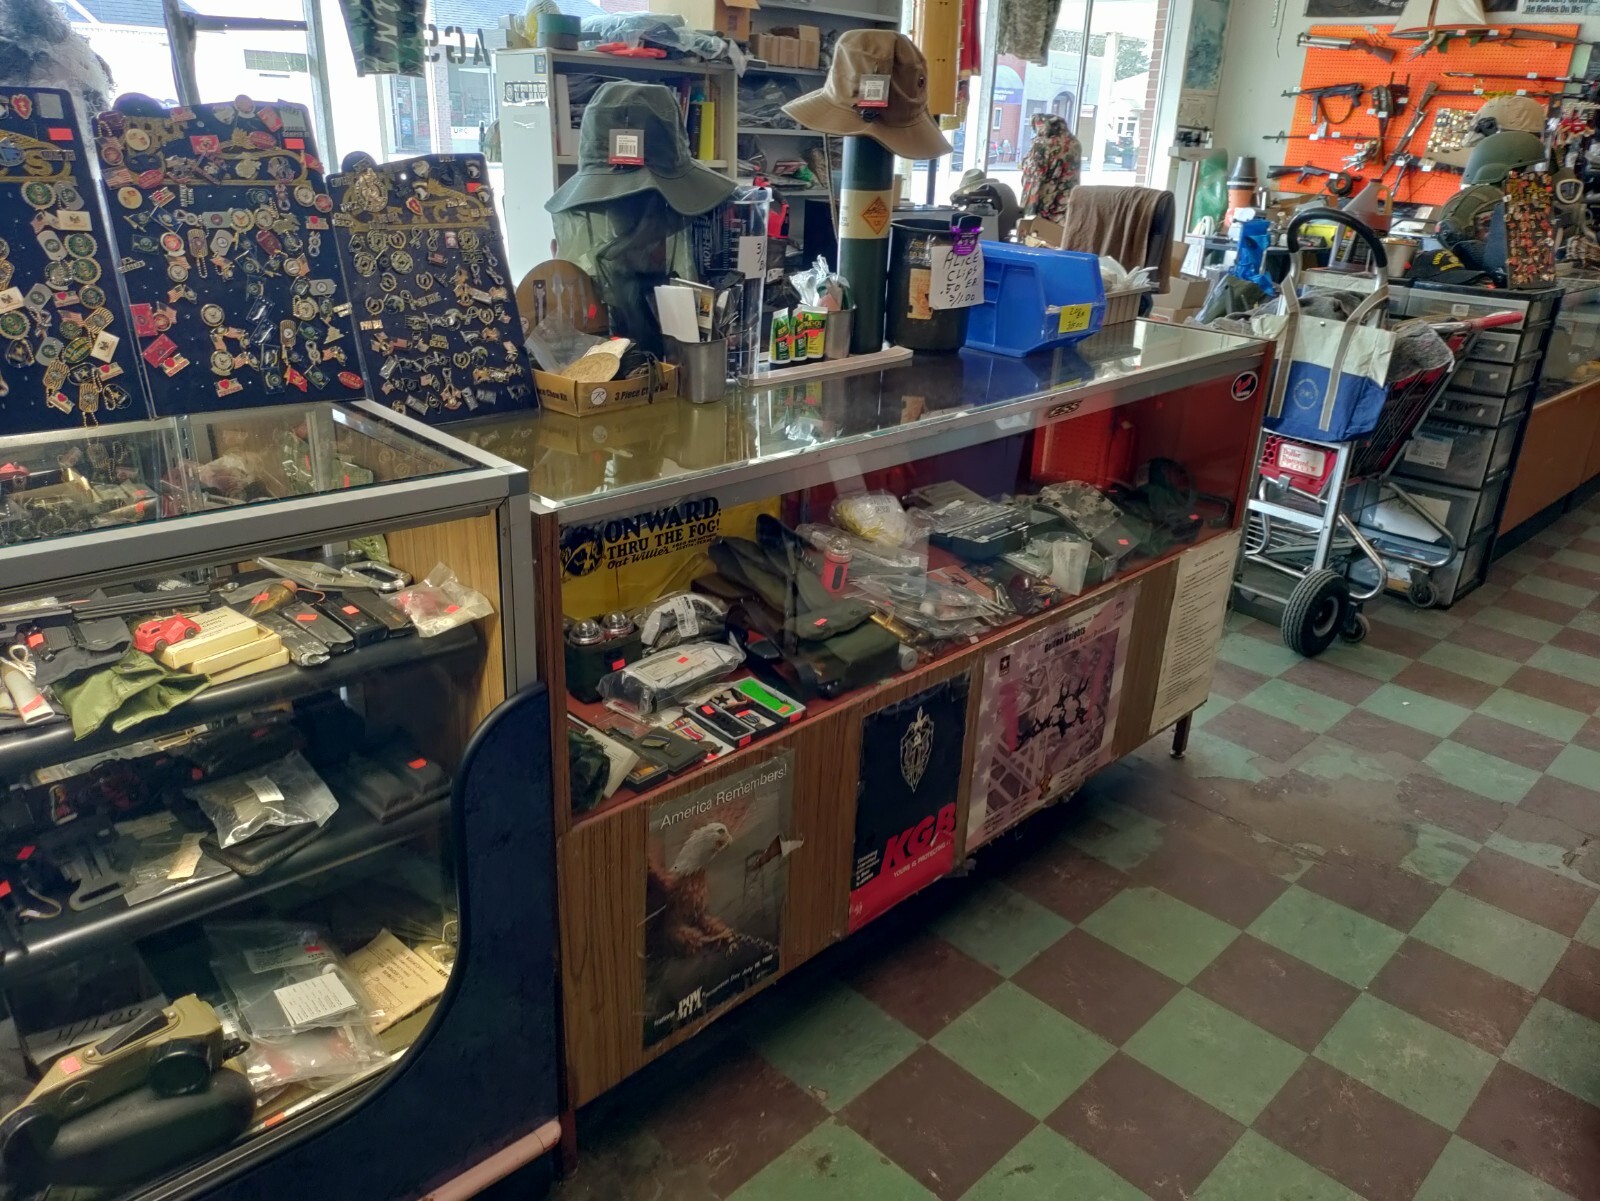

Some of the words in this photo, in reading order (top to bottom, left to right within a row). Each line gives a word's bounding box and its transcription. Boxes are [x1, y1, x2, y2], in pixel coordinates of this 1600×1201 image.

[1526, 5, 1536, 13] He
[1537, 5, 1559, 13] Relies
[1560, 5, 1570, 13] On
[1571, 5, 1583, 13] Us!
[943, 250, 979, 269] ALICE
[607, 537, 649, 560] THRU
[654, 528, 684, 548] THE
[689, 518, 719, 539] FOG!
[607, 557, 629, 570] Oat
[1064, 626, 1086, 643] Knights
[660, 798, 712, 830] America
[716, 763, 787, 806] Remembers!
[880, 802, 957, 876] KGB
[917, 842, 946, 864] PROTECTING
